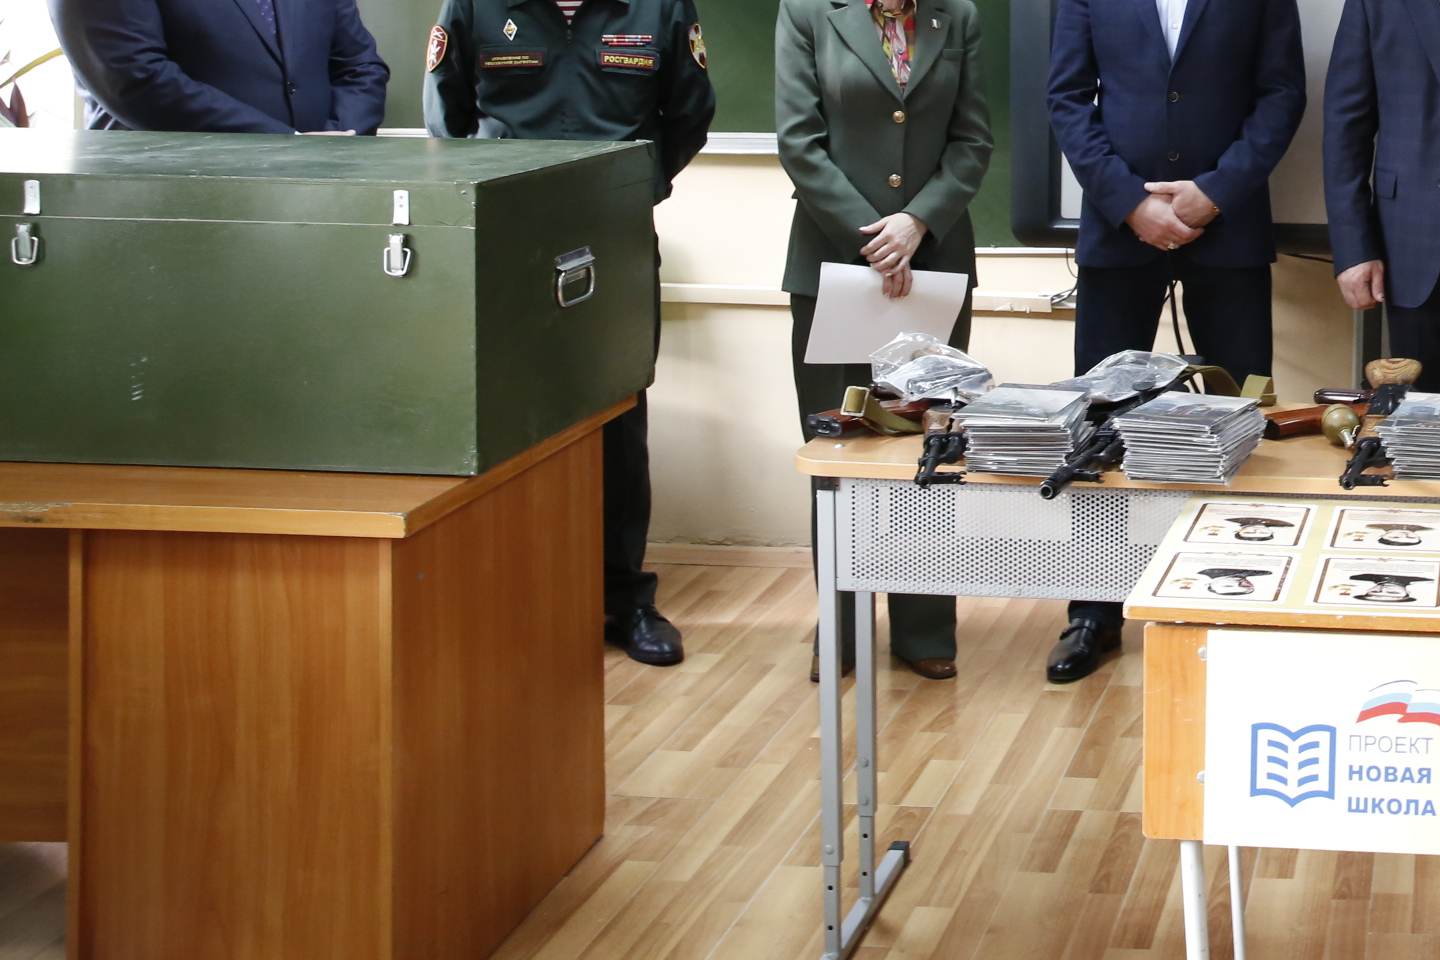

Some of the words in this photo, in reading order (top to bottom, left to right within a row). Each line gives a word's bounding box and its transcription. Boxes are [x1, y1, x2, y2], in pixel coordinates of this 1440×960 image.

[604, 55, 653, 66] РОСГВАРДИЯ
[1348, 735, 1434, 754] ПРОЕКТ
[1348, 764, 1432, 784] НОВАЯ
[1347, 796, 1437, 817] ШКОЛА
